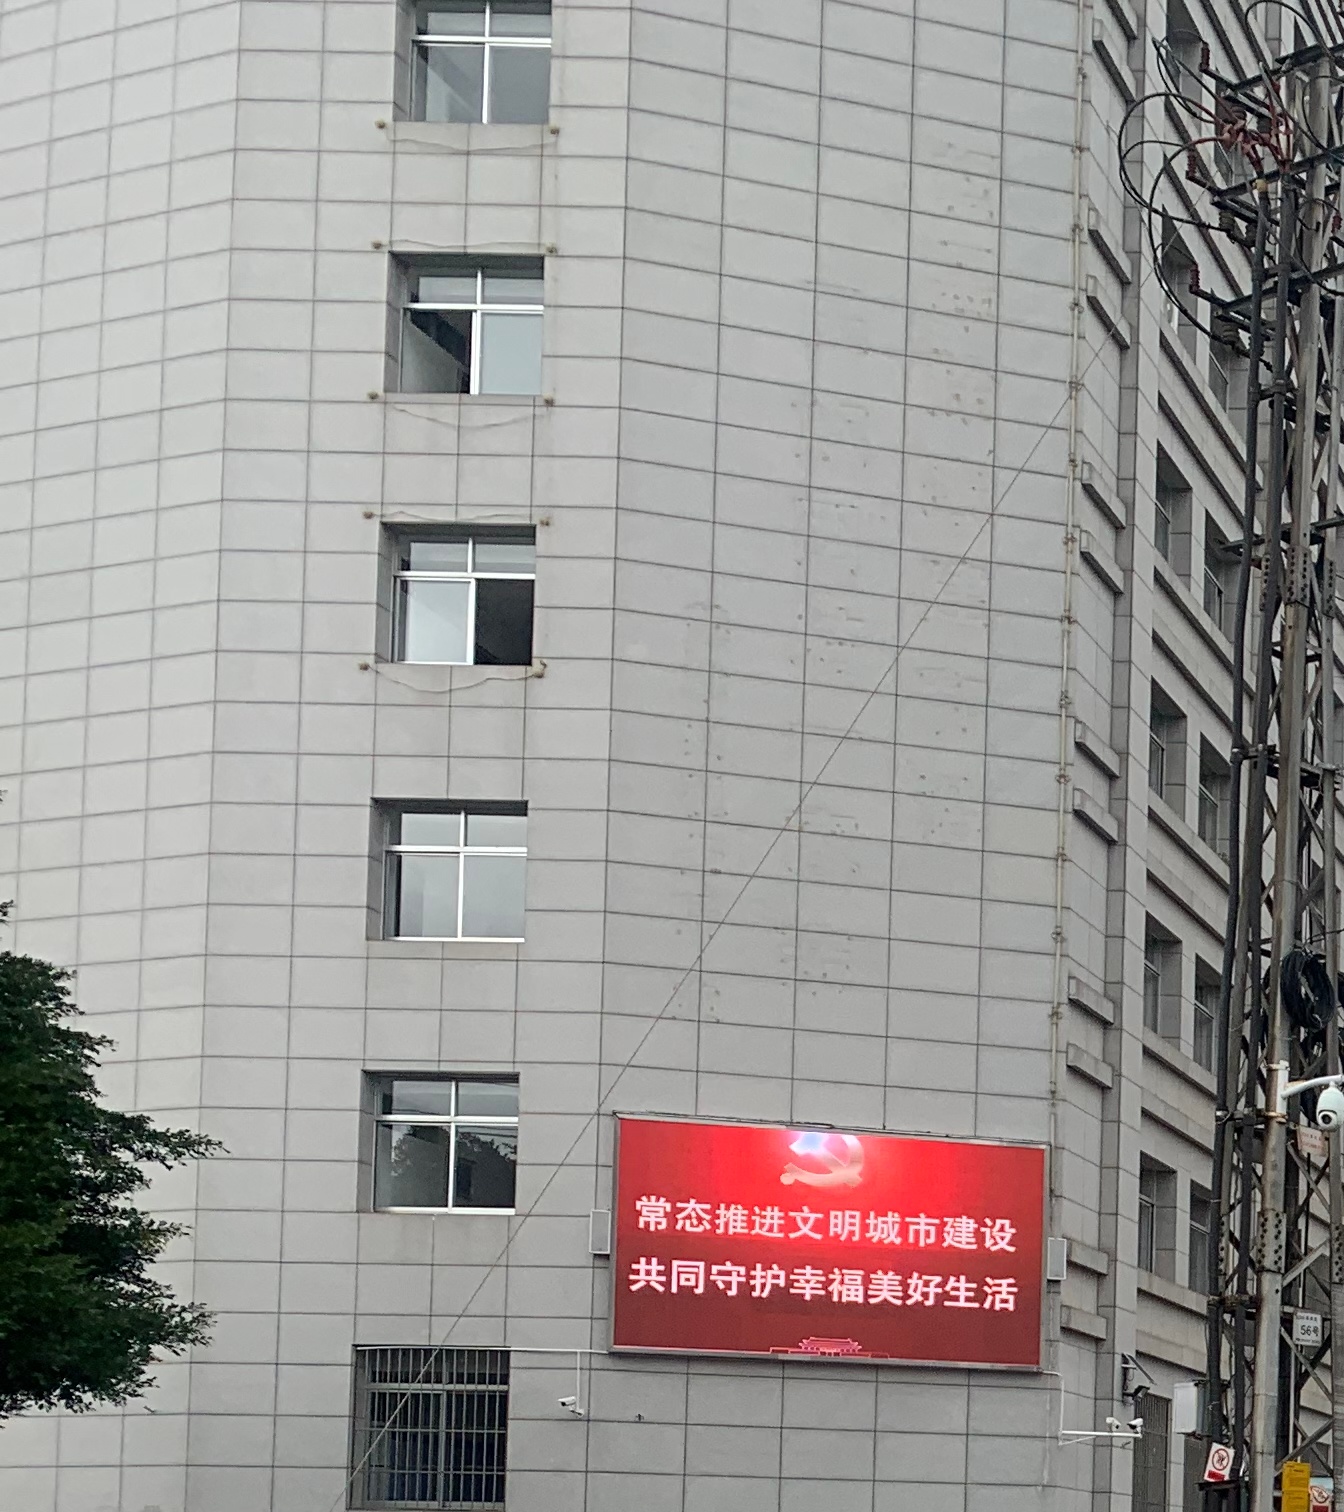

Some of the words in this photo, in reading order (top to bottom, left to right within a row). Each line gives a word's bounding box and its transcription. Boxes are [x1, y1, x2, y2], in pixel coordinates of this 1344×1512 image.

[635, 1195, 1017, 1253] 常态推进文明城市建设
[628, 1258, 1018, 1312] 共同守护幸福美好生活
